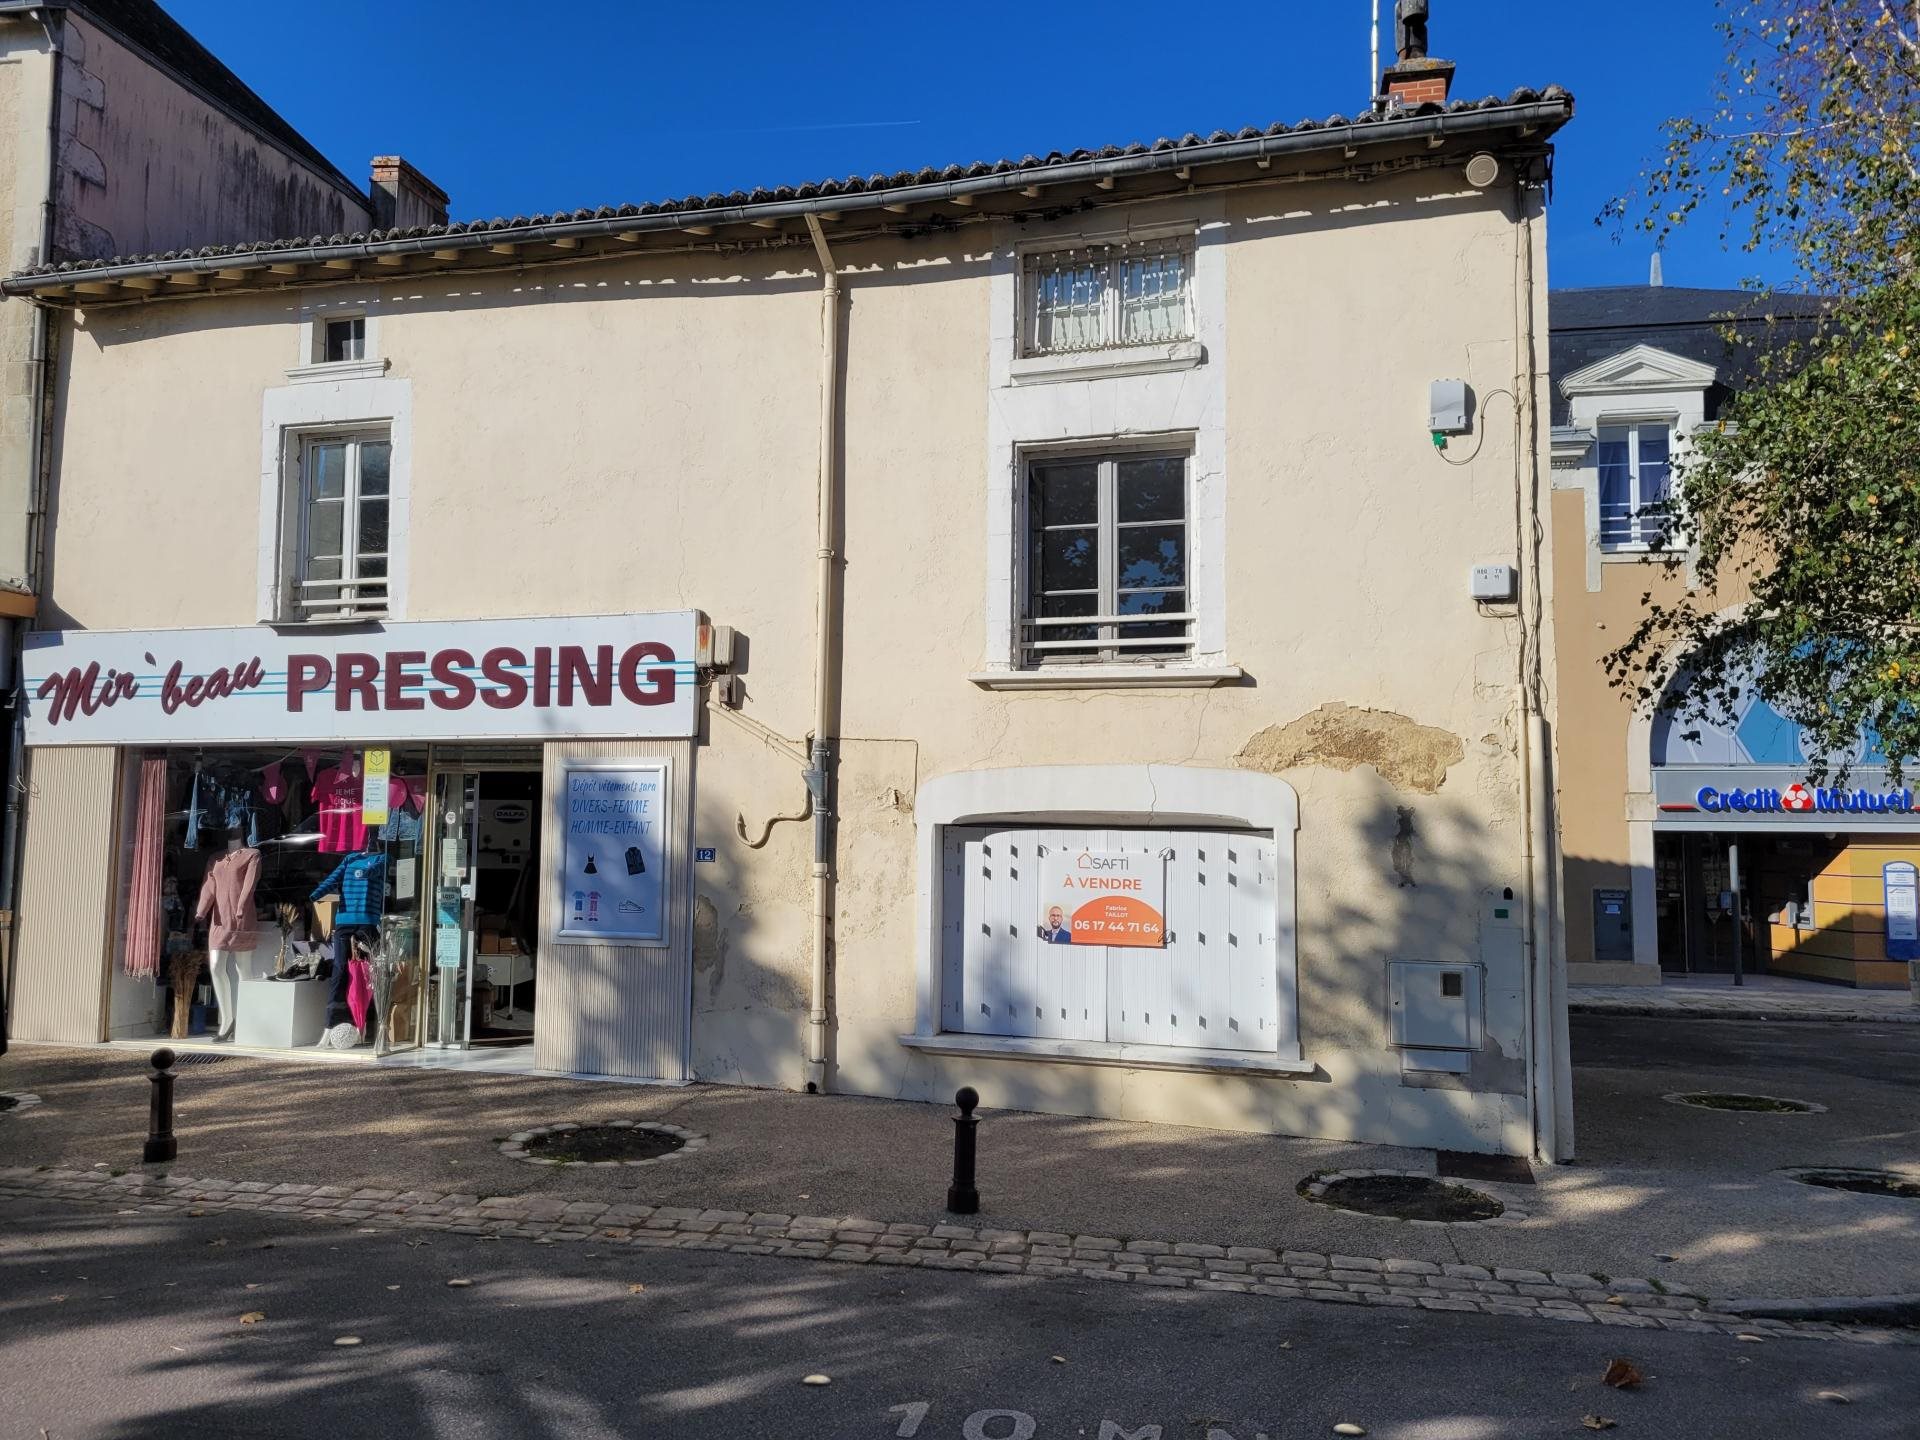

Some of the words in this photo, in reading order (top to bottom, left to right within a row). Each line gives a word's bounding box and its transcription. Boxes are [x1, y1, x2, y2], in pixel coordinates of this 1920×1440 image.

[286, 641, 676, 713] PRESSING
[1695, 785, 1782, 811] Crédit
[1813, 786, 1911, 811] Mutuel
[571, 820, 653, 836] HOMME-ENFANT
[699, 850, 711, 860] 12
[1063, 873, 1074, 888] À
[1078, 877, 1142, 891] VENDRE
[1074, 920, 1090, 930] 06
[1092, 921, 1105, 931] 17
[1108, 922, 1125, 932] 44
[1127, 922, 1140, 932] 71
[1142, 923, 1160, 934] 64
